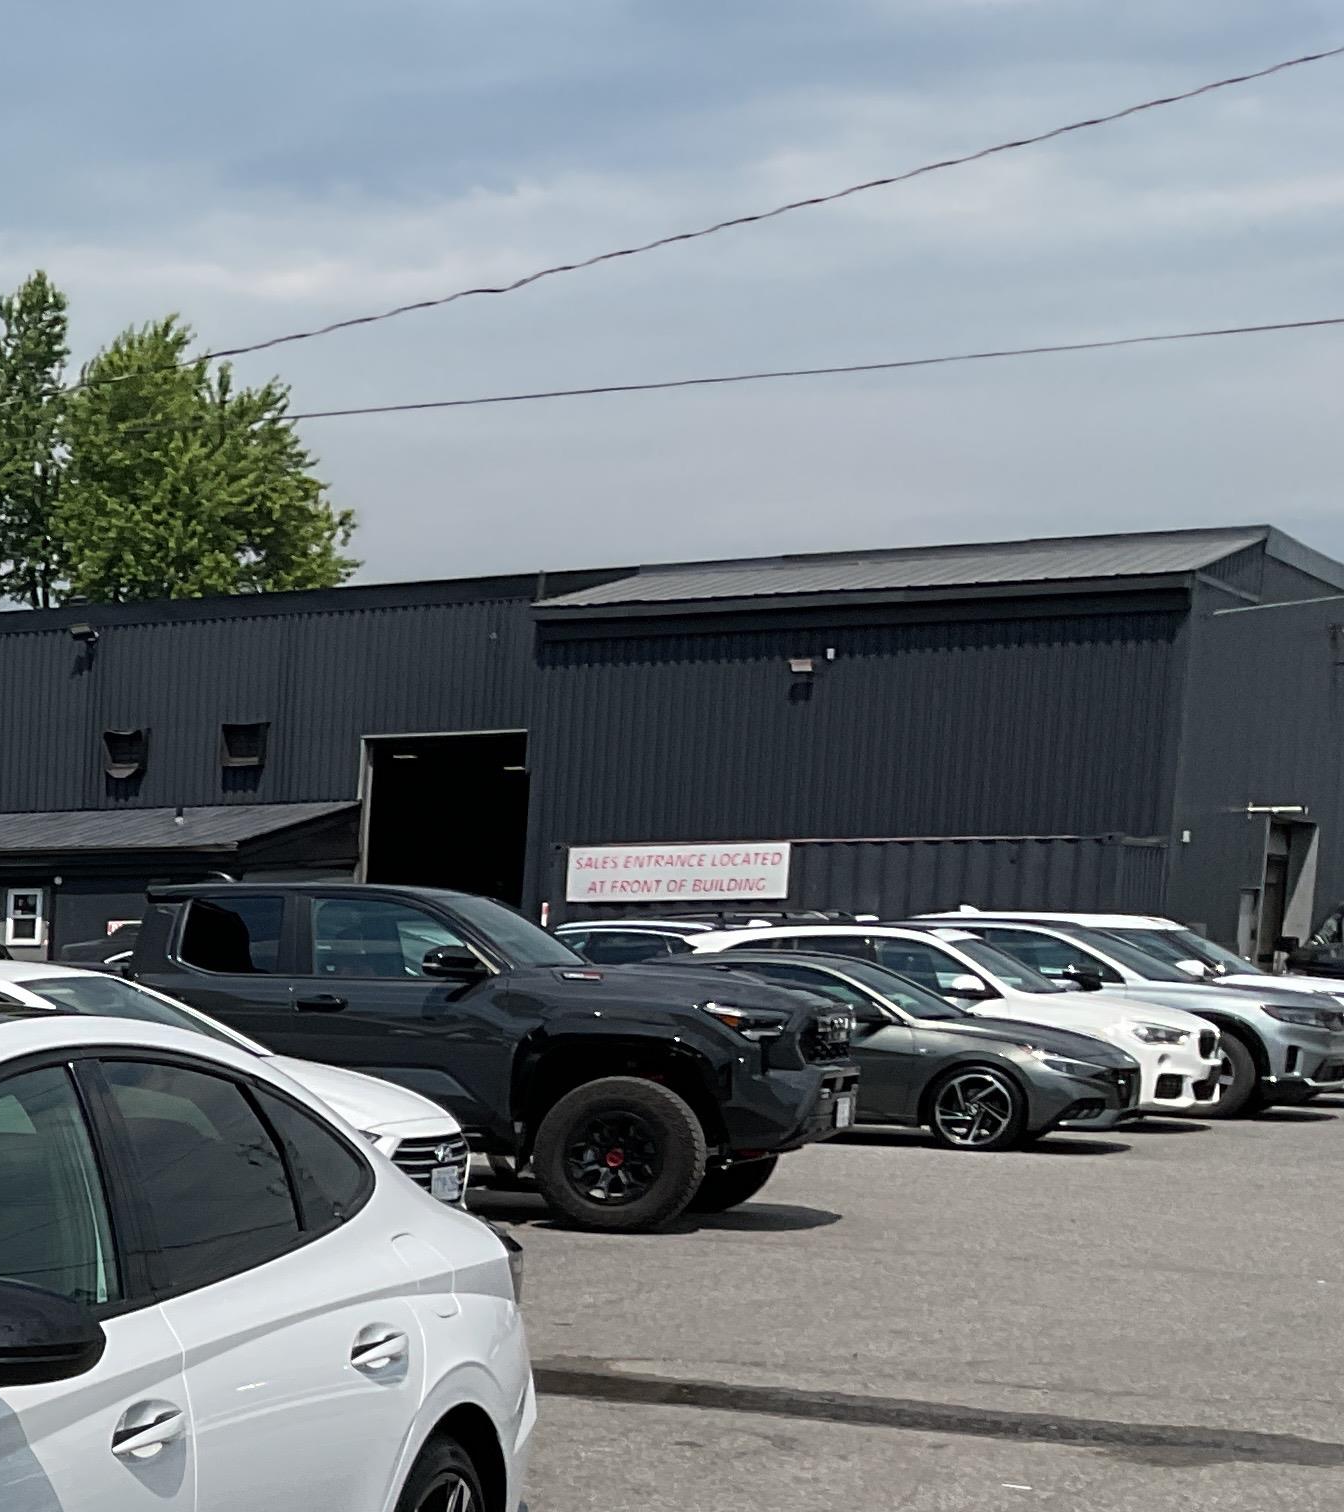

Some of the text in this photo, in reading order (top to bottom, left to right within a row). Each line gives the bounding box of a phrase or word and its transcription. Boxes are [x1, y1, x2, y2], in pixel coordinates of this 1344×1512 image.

[575, 851, 783, 871] SALES ENTRANCE LOCATED
[587, 877, 766, 894] AT FRONT OF BUILDING
